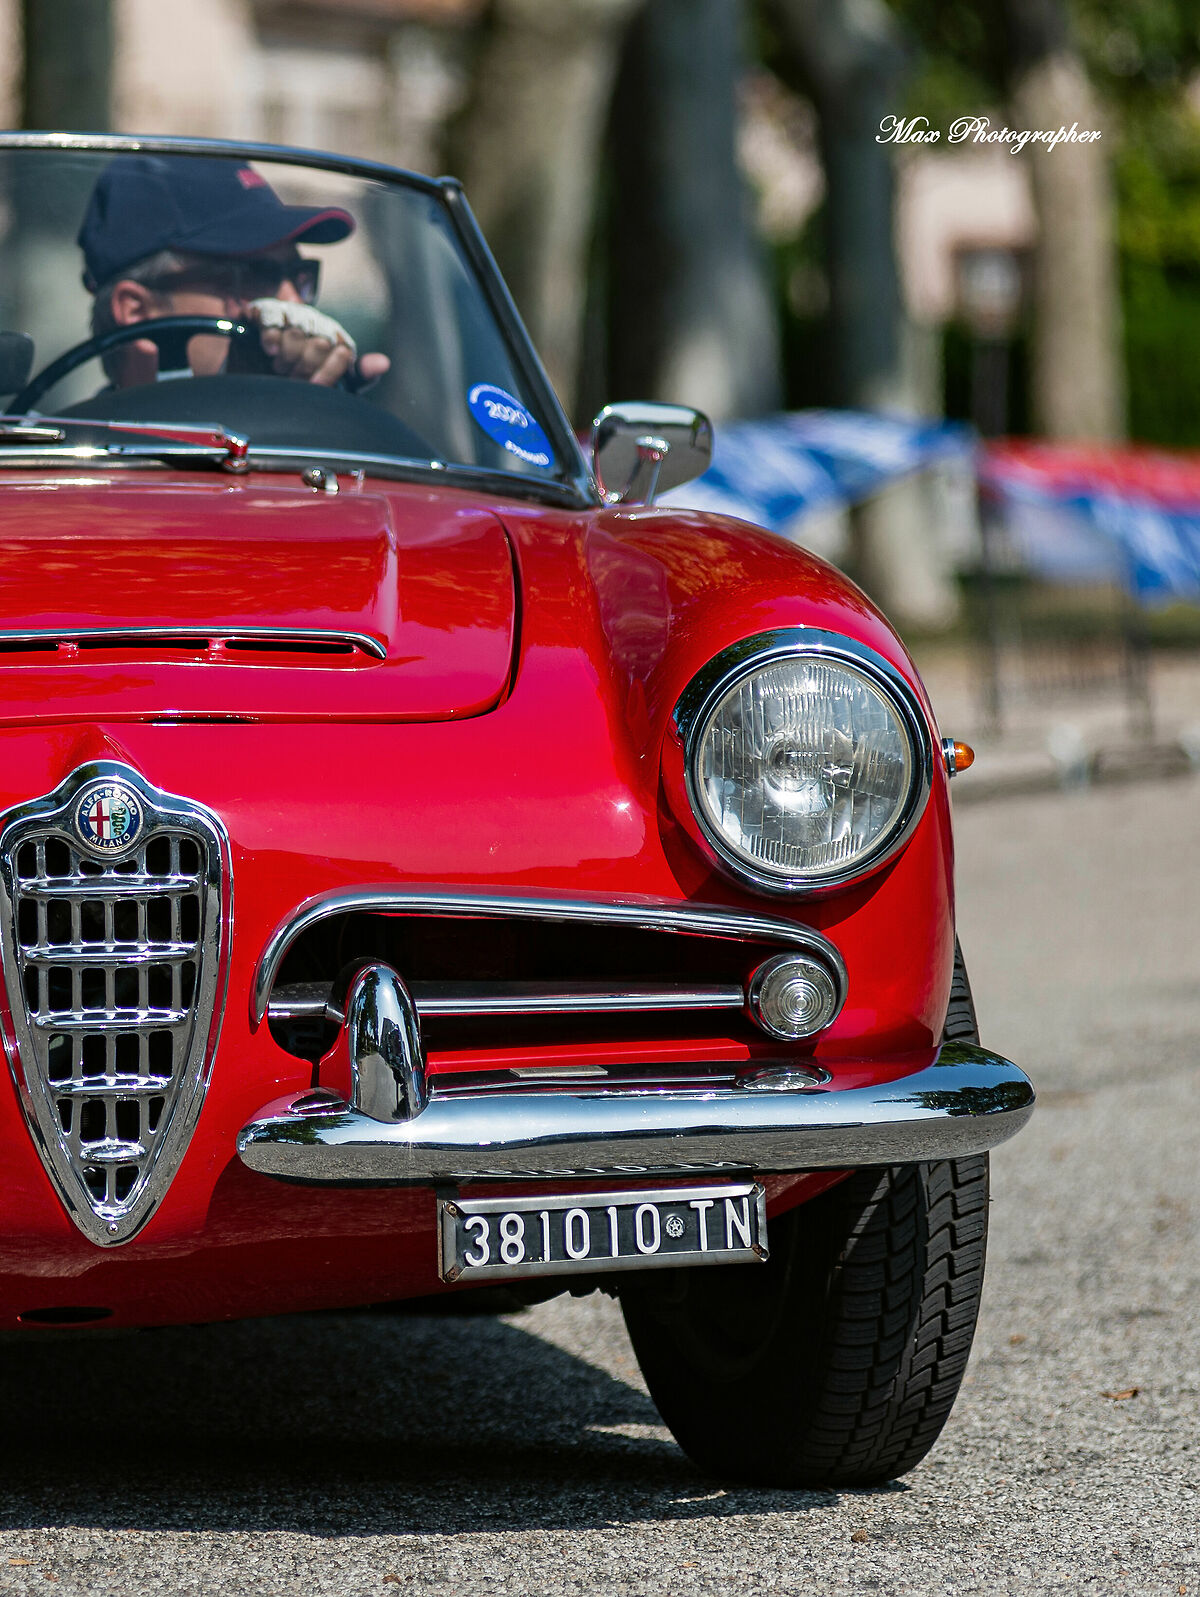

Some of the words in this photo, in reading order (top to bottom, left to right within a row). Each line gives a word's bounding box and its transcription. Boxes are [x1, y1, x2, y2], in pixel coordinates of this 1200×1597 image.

[89, 833, 130, 847] MILANO
[464, 1203, 661, 1267] 381010
[689, 1197, 751, 1251] TN
